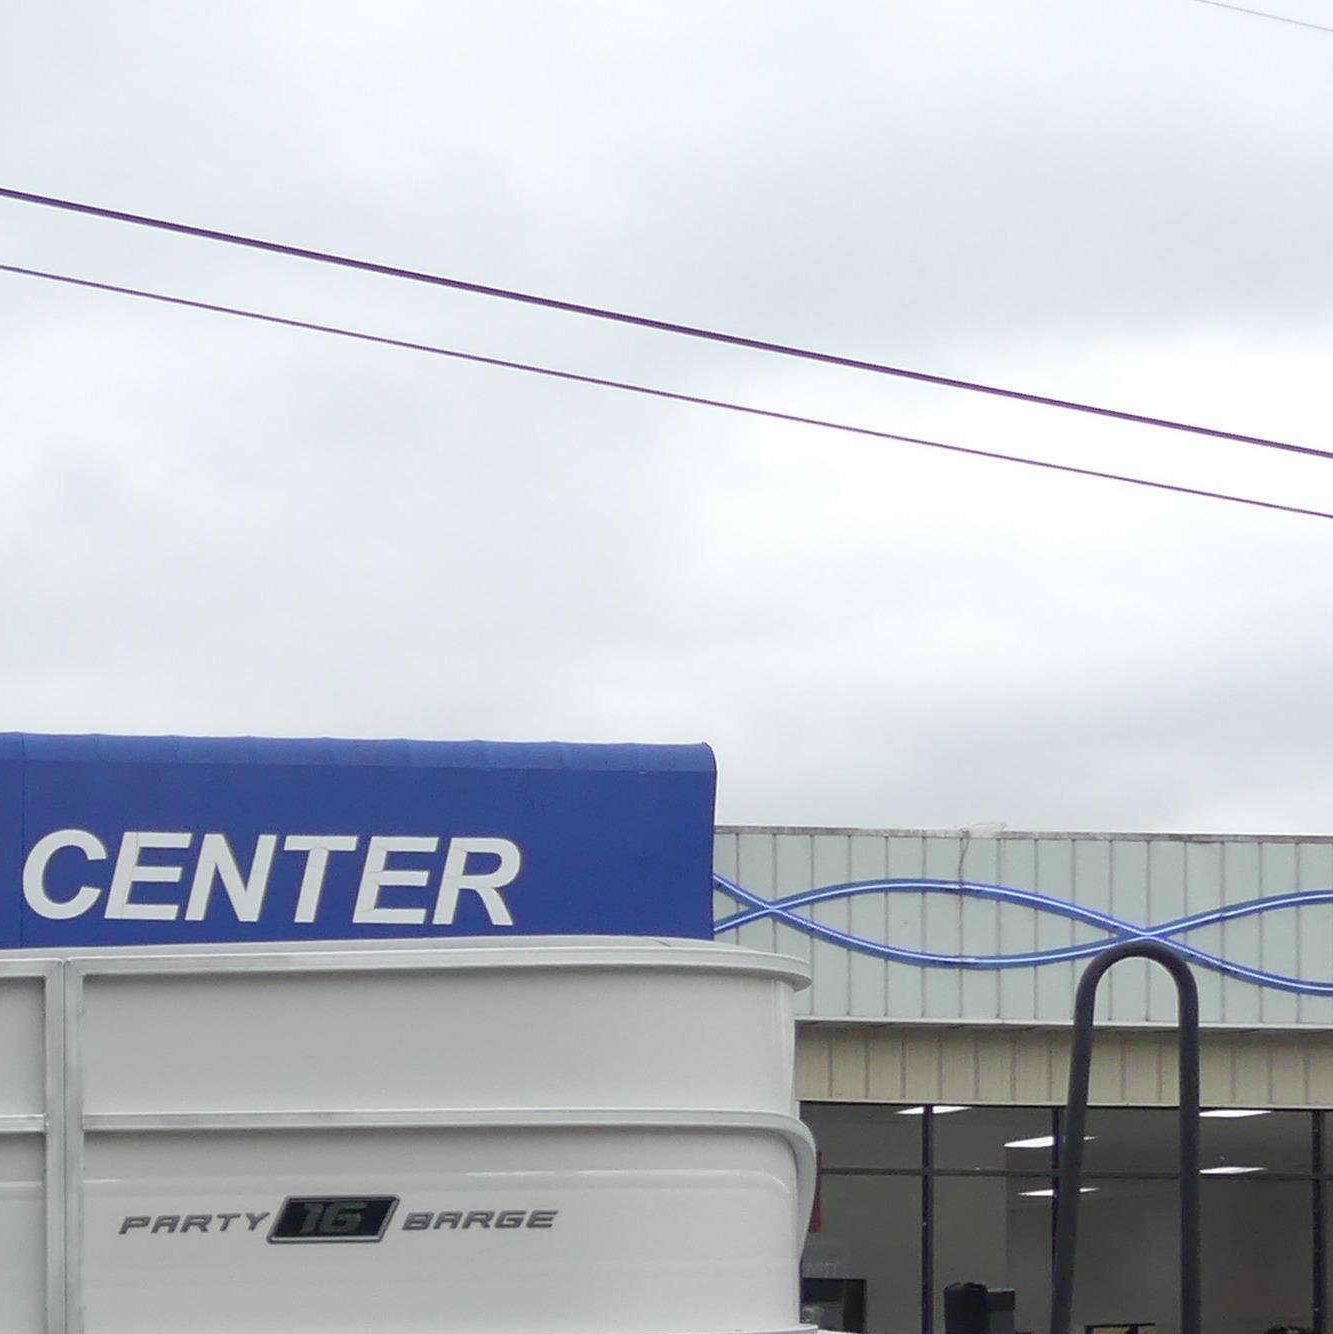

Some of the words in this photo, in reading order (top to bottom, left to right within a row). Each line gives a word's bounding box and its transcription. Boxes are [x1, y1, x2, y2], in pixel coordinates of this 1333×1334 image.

[23, 829, 523, 926] CENTER
[118, 1212, 271, 1235] PARTY
[298, 1202, 370, 1234] 16
[401, 1210, 559, 1231] BARGE
